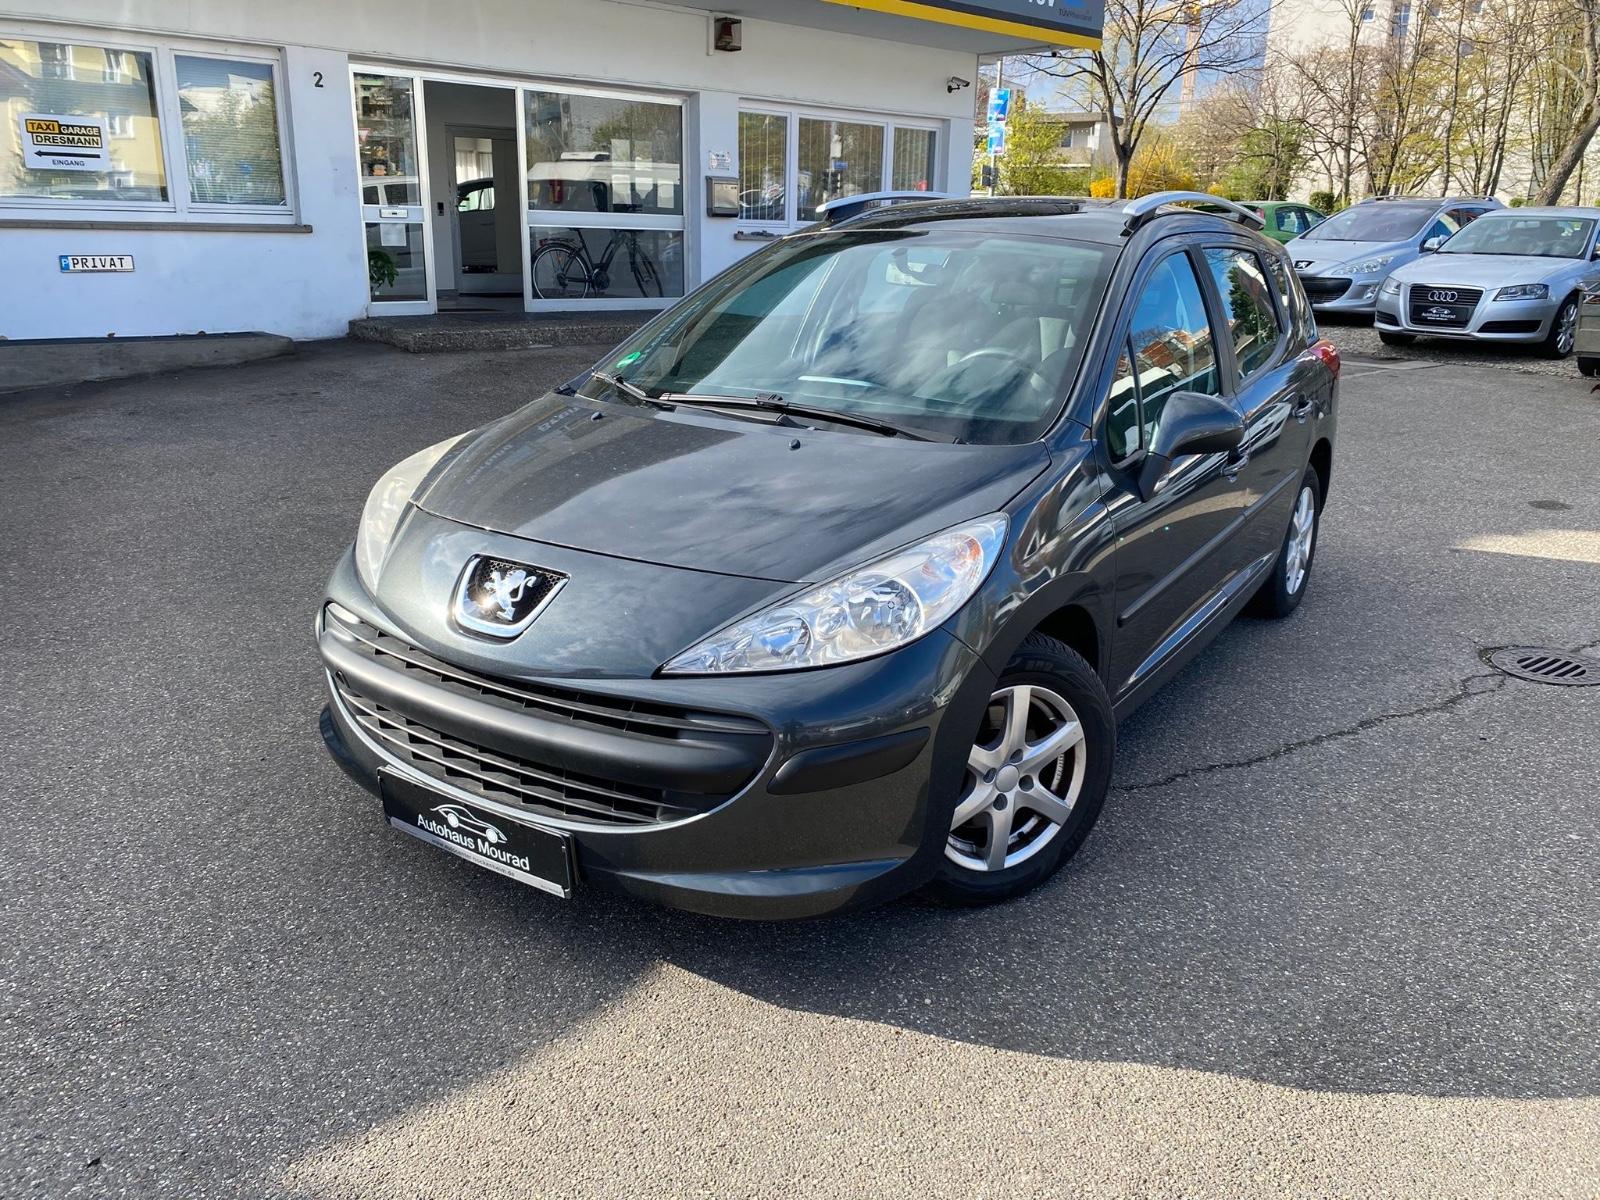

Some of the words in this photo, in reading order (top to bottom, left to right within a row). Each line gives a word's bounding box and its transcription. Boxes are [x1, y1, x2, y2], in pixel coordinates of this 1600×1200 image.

[313, 71, 324, 88] 2
[29, 121, 56, 132] TAXI
[60, 125, 100, 135] GARAGE
[35, 134, 99, 146] DRESMANN
[52, 159, 85, 167] EINGANG
[71, 257, 124, 269] PRIVAT
[417, 813, 475, 849] Autohaus
[477, 838, 530, 871] Mourad
